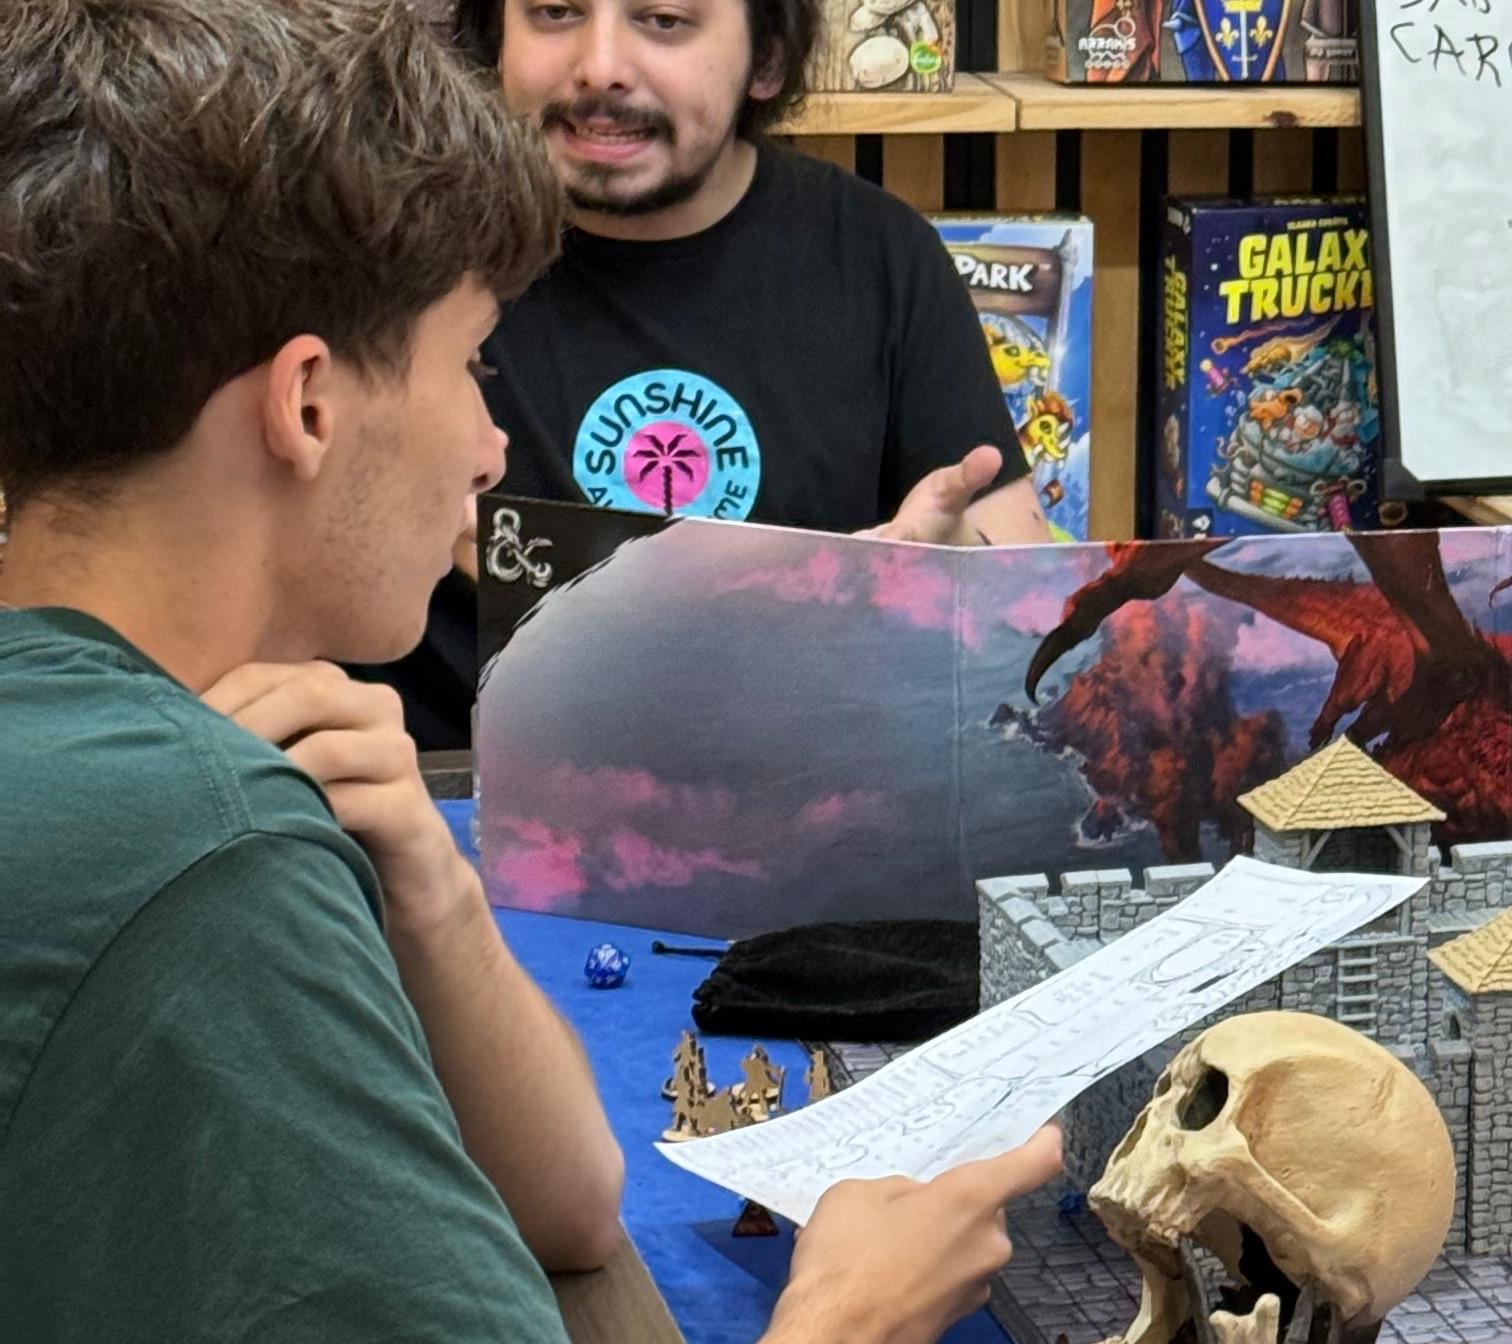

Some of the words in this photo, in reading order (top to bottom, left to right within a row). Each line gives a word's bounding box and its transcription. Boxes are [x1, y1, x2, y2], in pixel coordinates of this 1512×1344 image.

[1390, 23, 1501, 88] CAR
[1238, 227, 1370, 280] GALAX
[584, 382, 749, 476] SUNSHINE
